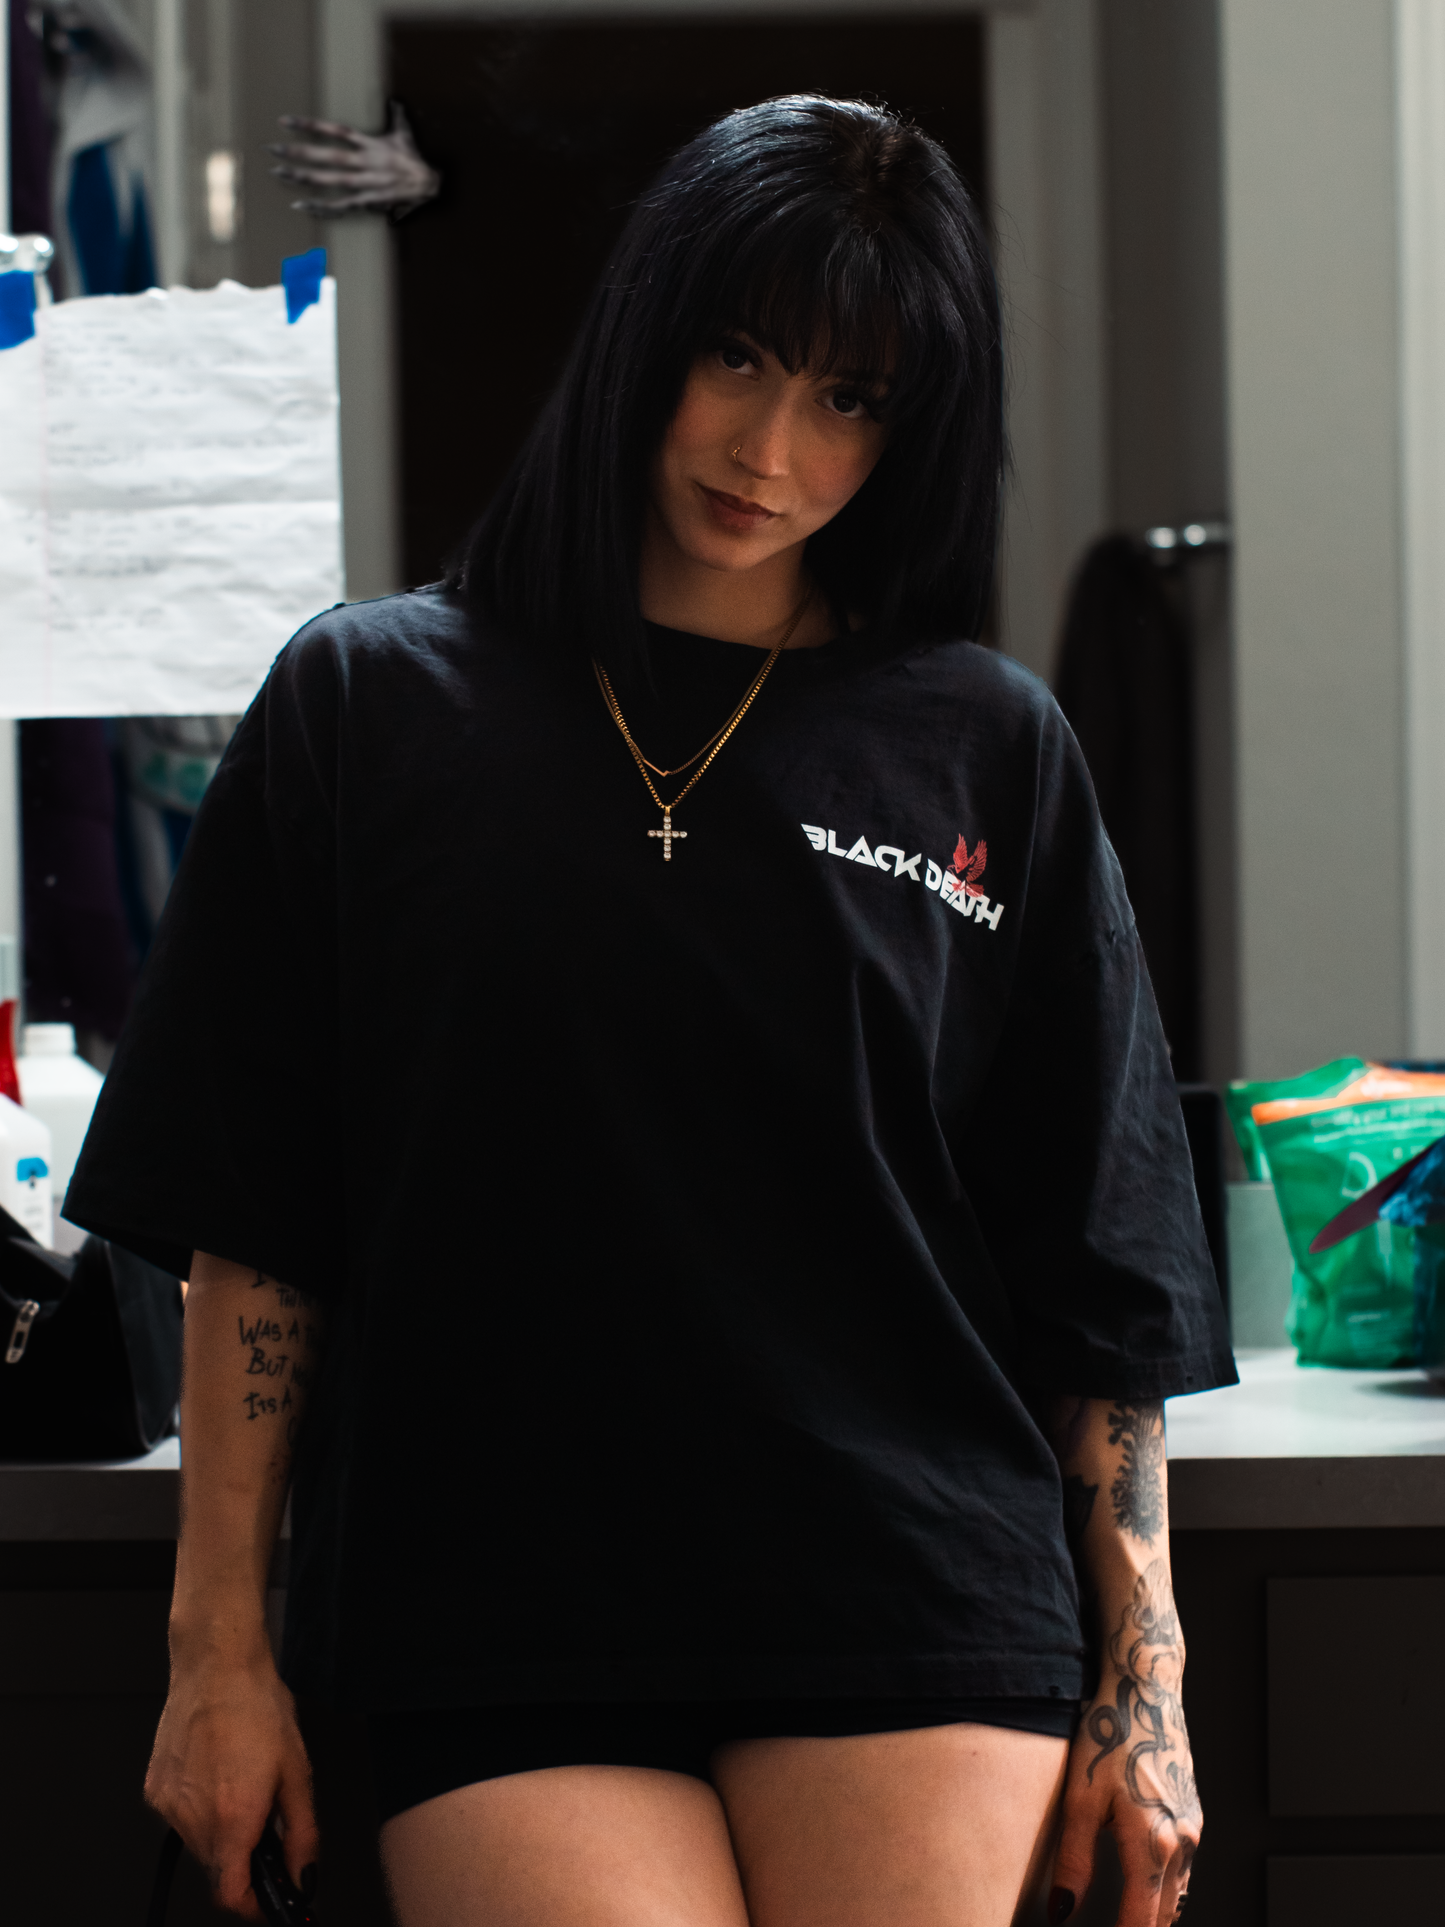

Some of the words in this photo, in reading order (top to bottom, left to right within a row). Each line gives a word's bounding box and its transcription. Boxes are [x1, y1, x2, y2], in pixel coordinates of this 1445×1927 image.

[801, 823, 922, 882] BLACK
[925, 858, 1005, 932] DEATH
[238, 1315, 282, 1346] WAS
[287, 1317, 300, 1344] A
[246, 1347, 289, 1377] BUT
